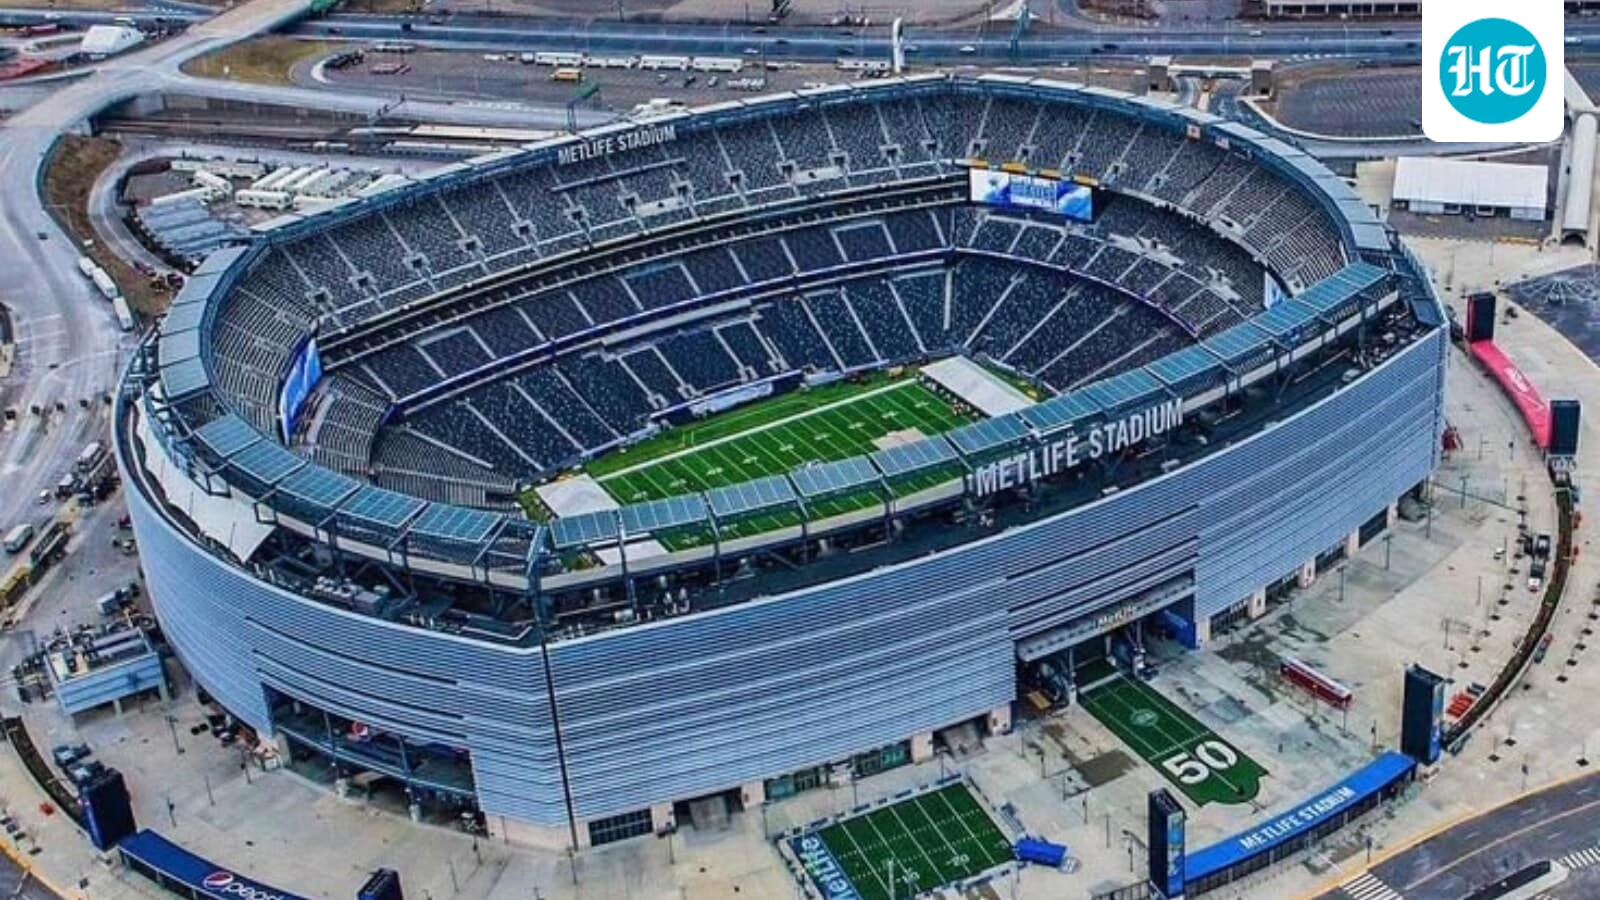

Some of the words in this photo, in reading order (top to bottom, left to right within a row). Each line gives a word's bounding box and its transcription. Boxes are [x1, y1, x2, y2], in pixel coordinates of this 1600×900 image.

[558, 137, 615, 165] METLIFE
[617, 125, 677, 151] STADIUM
[976, 436, 1080, 498] METLIFE
[1089, 398, 1184, 459] STADIUM
[1162, 741, 1238, 784] 50
[1239, 815, 1303, 849] METLIFE
[1298, 786, 1356, 820] STADIUM
